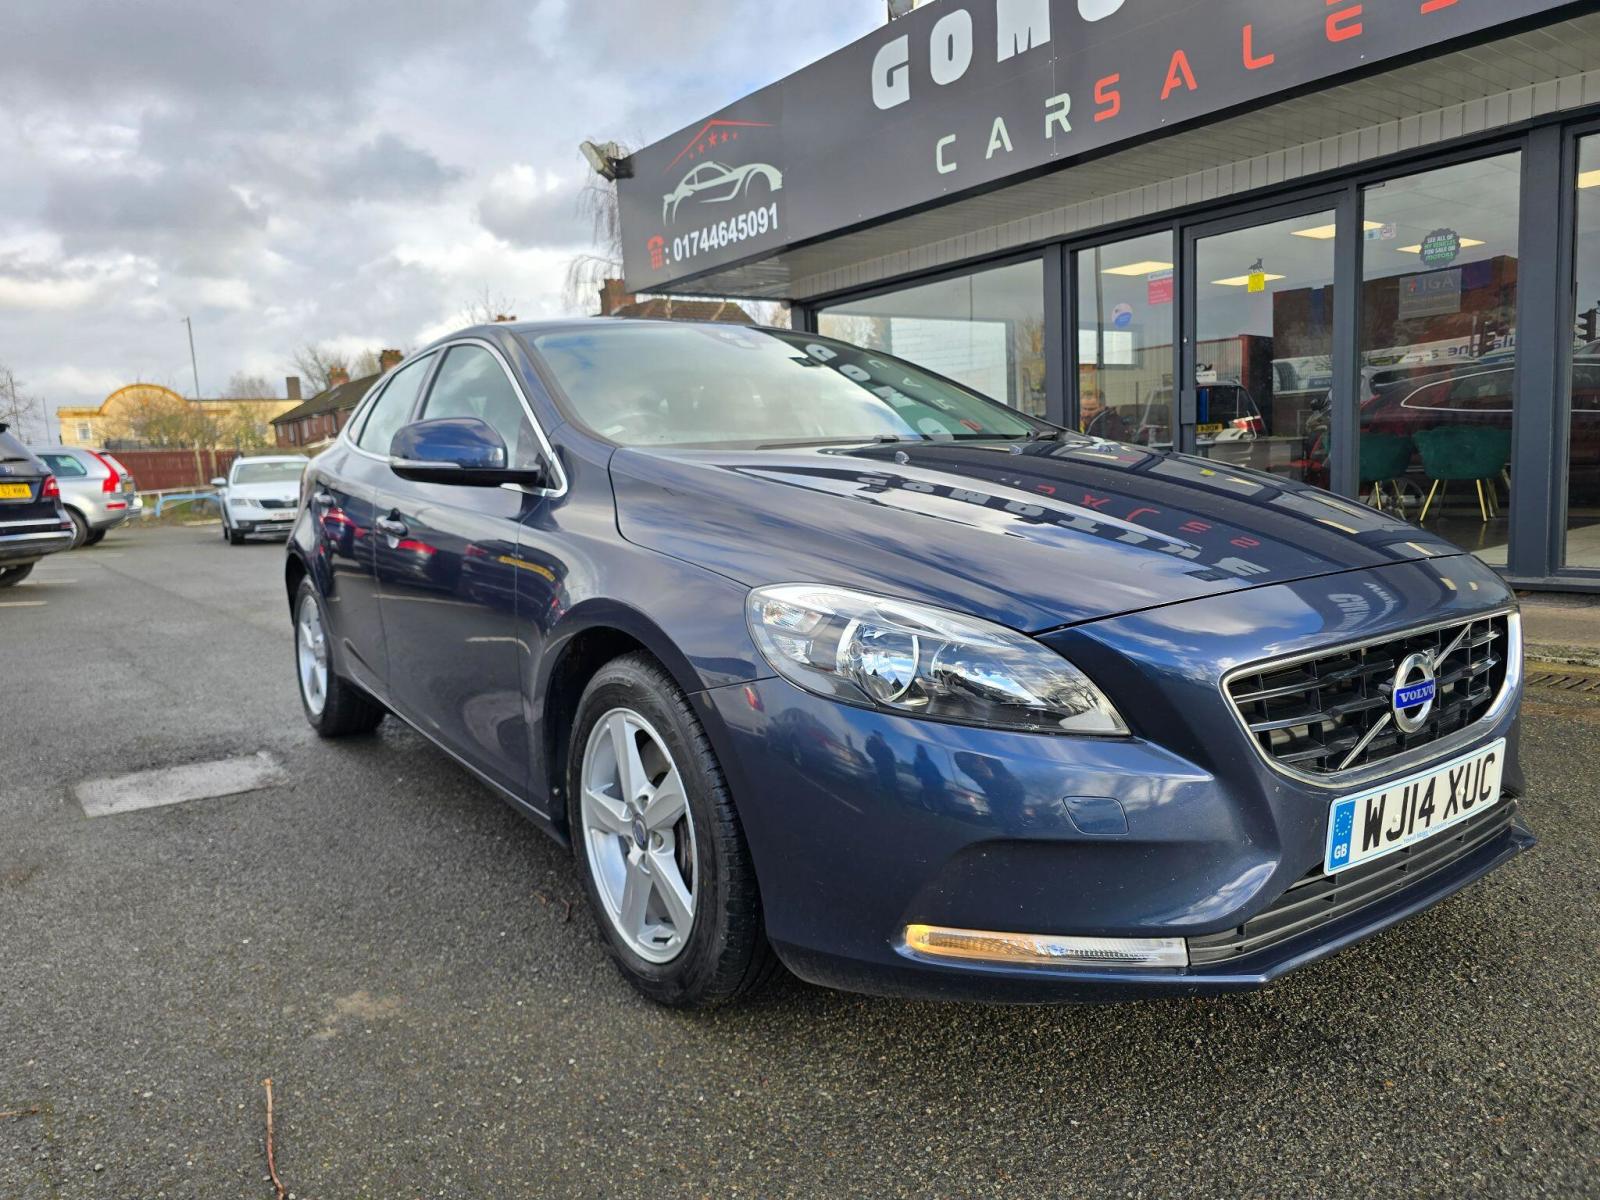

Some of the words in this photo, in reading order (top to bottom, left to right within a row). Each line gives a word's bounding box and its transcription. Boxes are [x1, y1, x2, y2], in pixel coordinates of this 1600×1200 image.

[872, 0, 1125, 110] GOM
[673, 202, 778, 262] 01744645091
[1399, 685, 1434, 703] VOLVO
[1362, 776, 1437, 852] WJ14
[1443, 752, 1496, 821] XUC
[1334, 843, 1348, 859] GB
